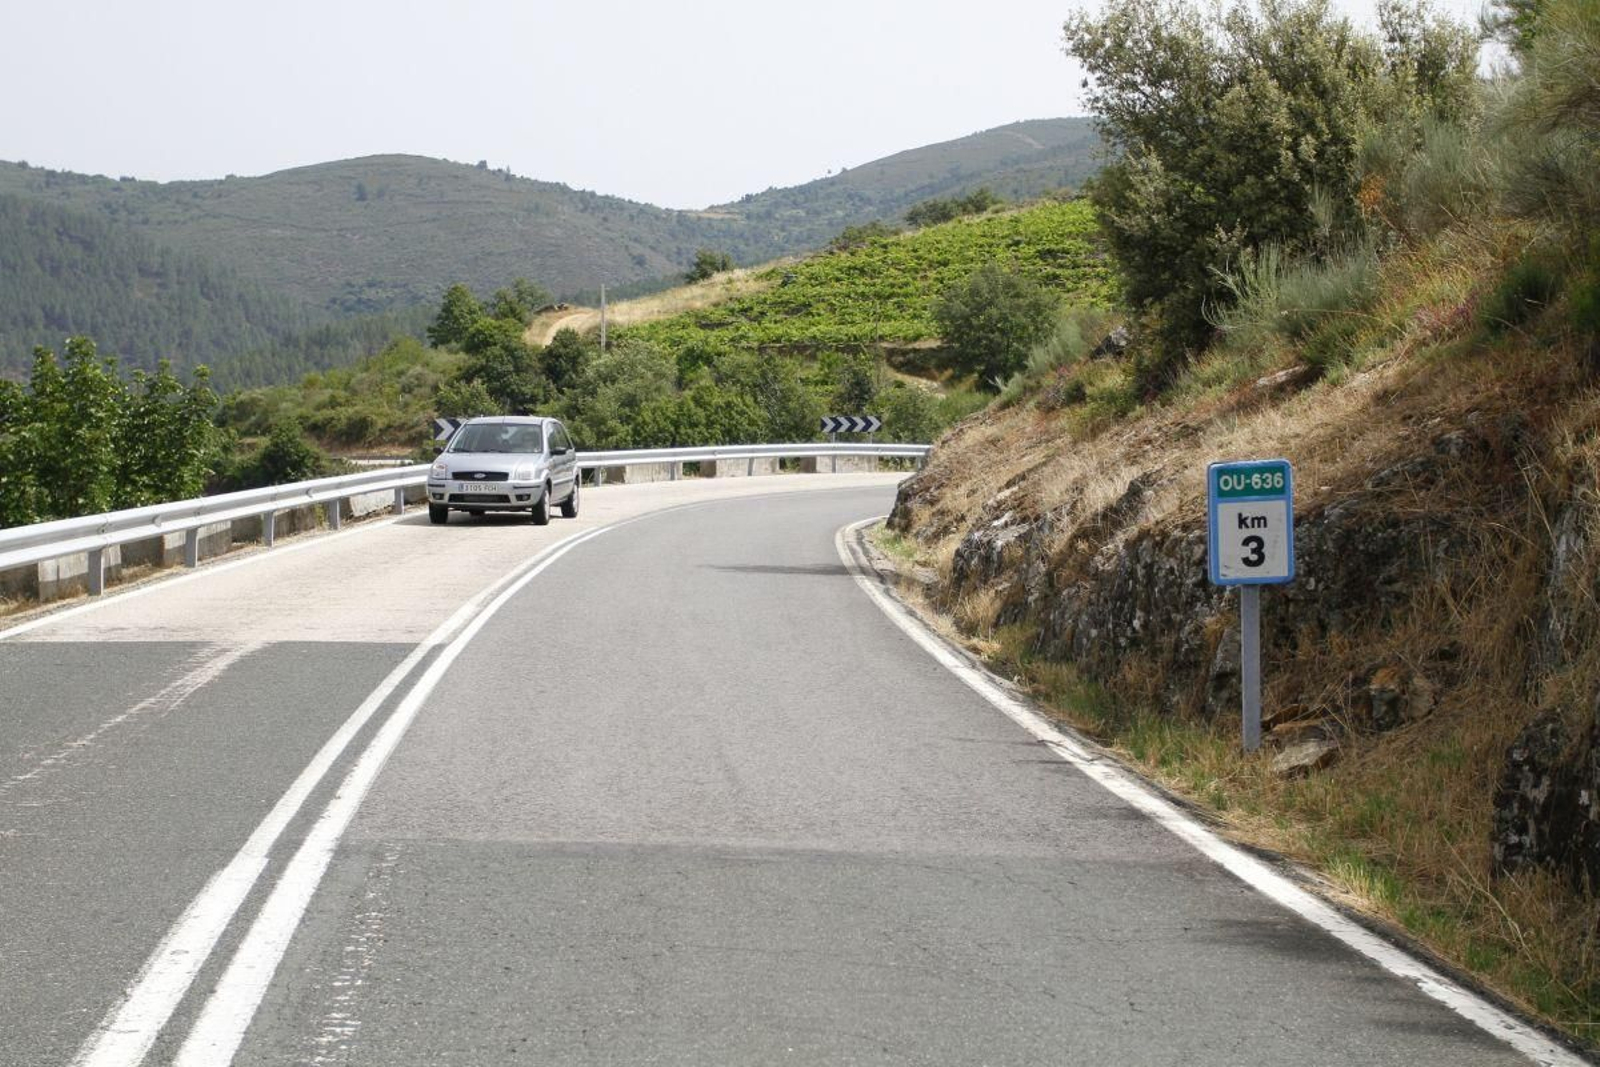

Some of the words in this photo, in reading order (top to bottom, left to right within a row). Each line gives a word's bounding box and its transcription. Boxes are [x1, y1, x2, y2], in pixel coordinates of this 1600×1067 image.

[1219, 472, 1284, 491] OU-636
[1237, 512, 1268, 530] km
[1241, 535, 1266, 568] 3
